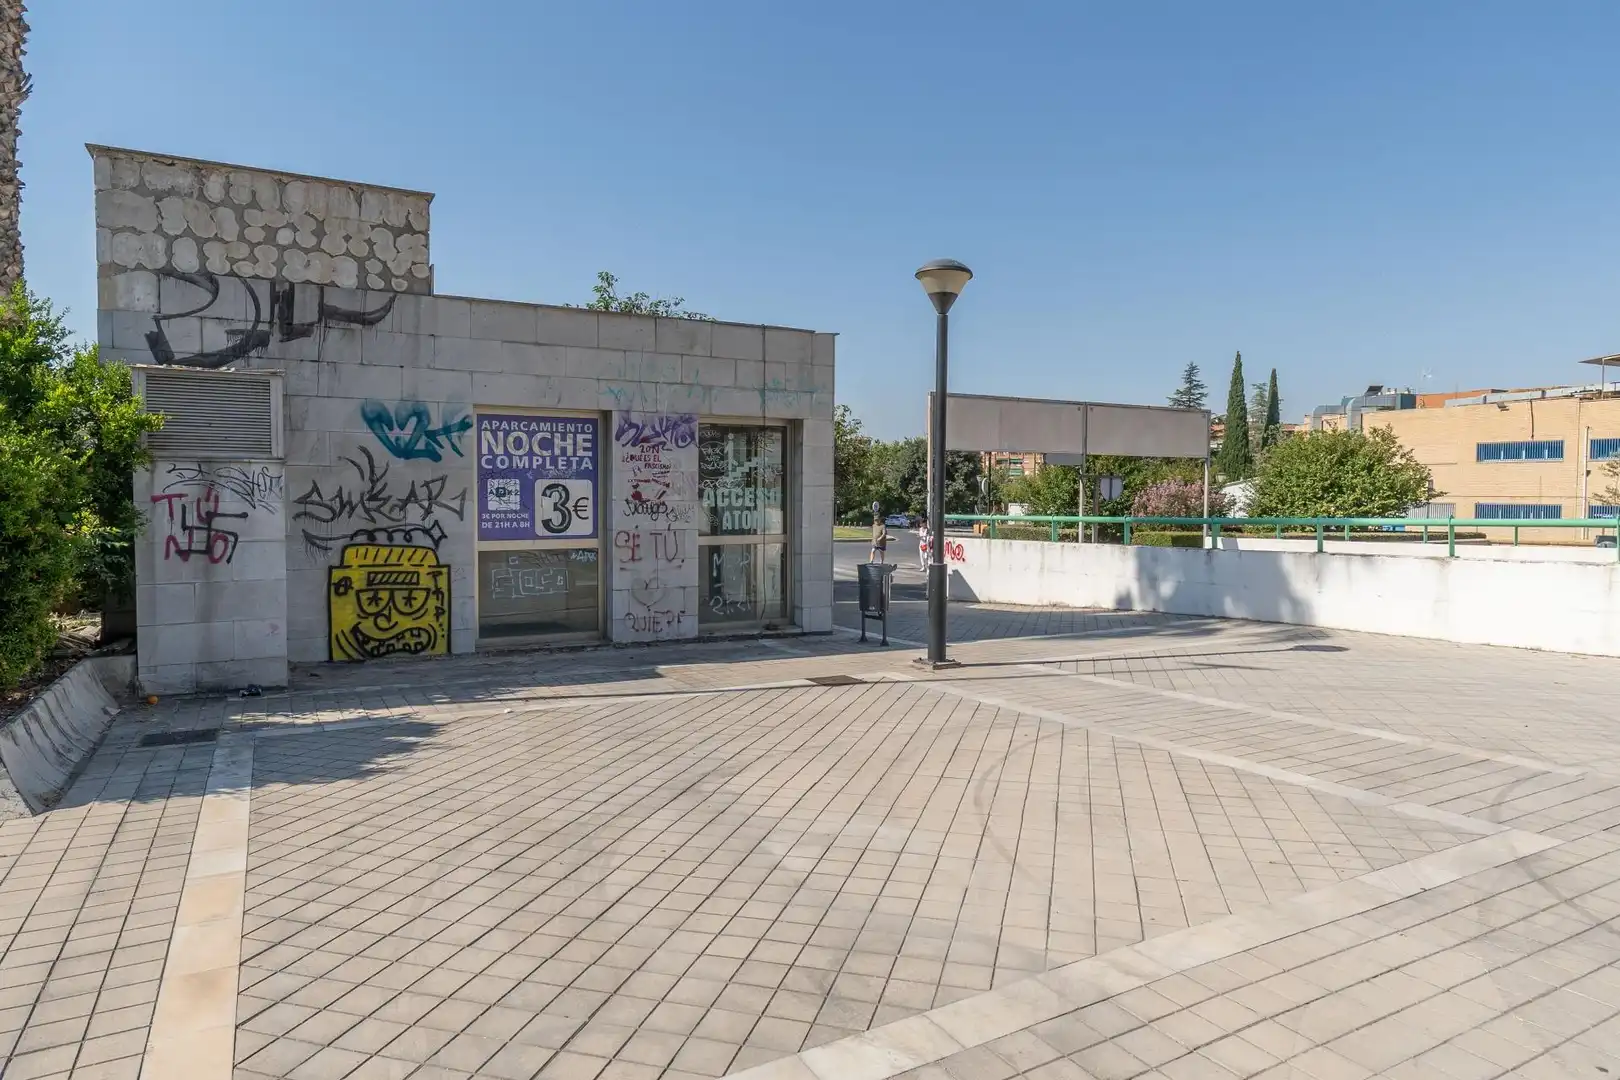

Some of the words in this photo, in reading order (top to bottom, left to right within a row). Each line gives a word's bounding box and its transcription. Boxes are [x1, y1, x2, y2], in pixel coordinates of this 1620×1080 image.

[481, 420, 593, 433] APARCAMIENTO
[481, 430, 593, 457] NOCHE
[481, 455, 593, 470] COMPLETA
[702, 487, 780, 507] ACCEO
[506, 512, 529, 520] NOCHE
[481, 521, 493, 529] DE
[494, 521, 511, 529] 21H
[519, 521, 531, 529] 8H
